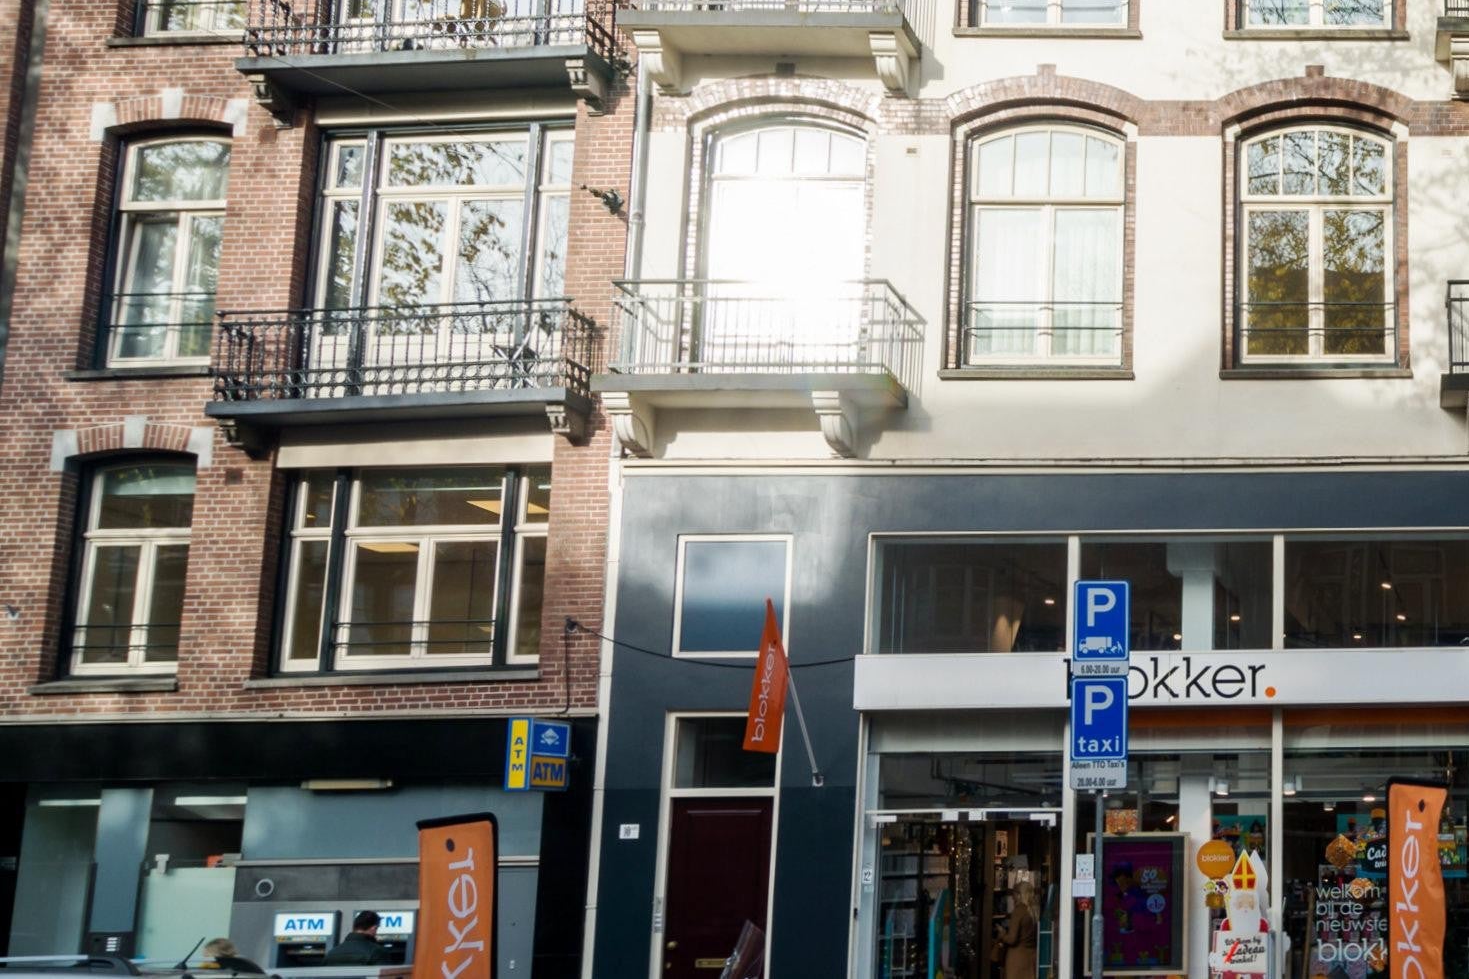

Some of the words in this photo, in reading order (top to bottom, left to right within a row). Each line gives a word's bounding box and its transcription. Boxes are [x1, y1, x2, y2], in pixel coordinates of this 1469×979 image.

[1087, 587, 1116, 627] P
[1063, 656, 1276, 699] okker.
[1111, 665, 1121, 673] uur
[752, 643, 776, 742] blokker
[1084, 685, 1114, 725] P
[1078, 735, 1120, 753] taxi
[532, 762, 563, 782] ATM
[1201, 854, 1231, 863] blokker
[1316, 882, 1381, 899] welkom
[1316, 900, 1337, 919] bij
[1344, 900, 1363, 915] de
[284, 918, 324, 931] ATM
[1316, 917, 1388, 932] nieuwste
